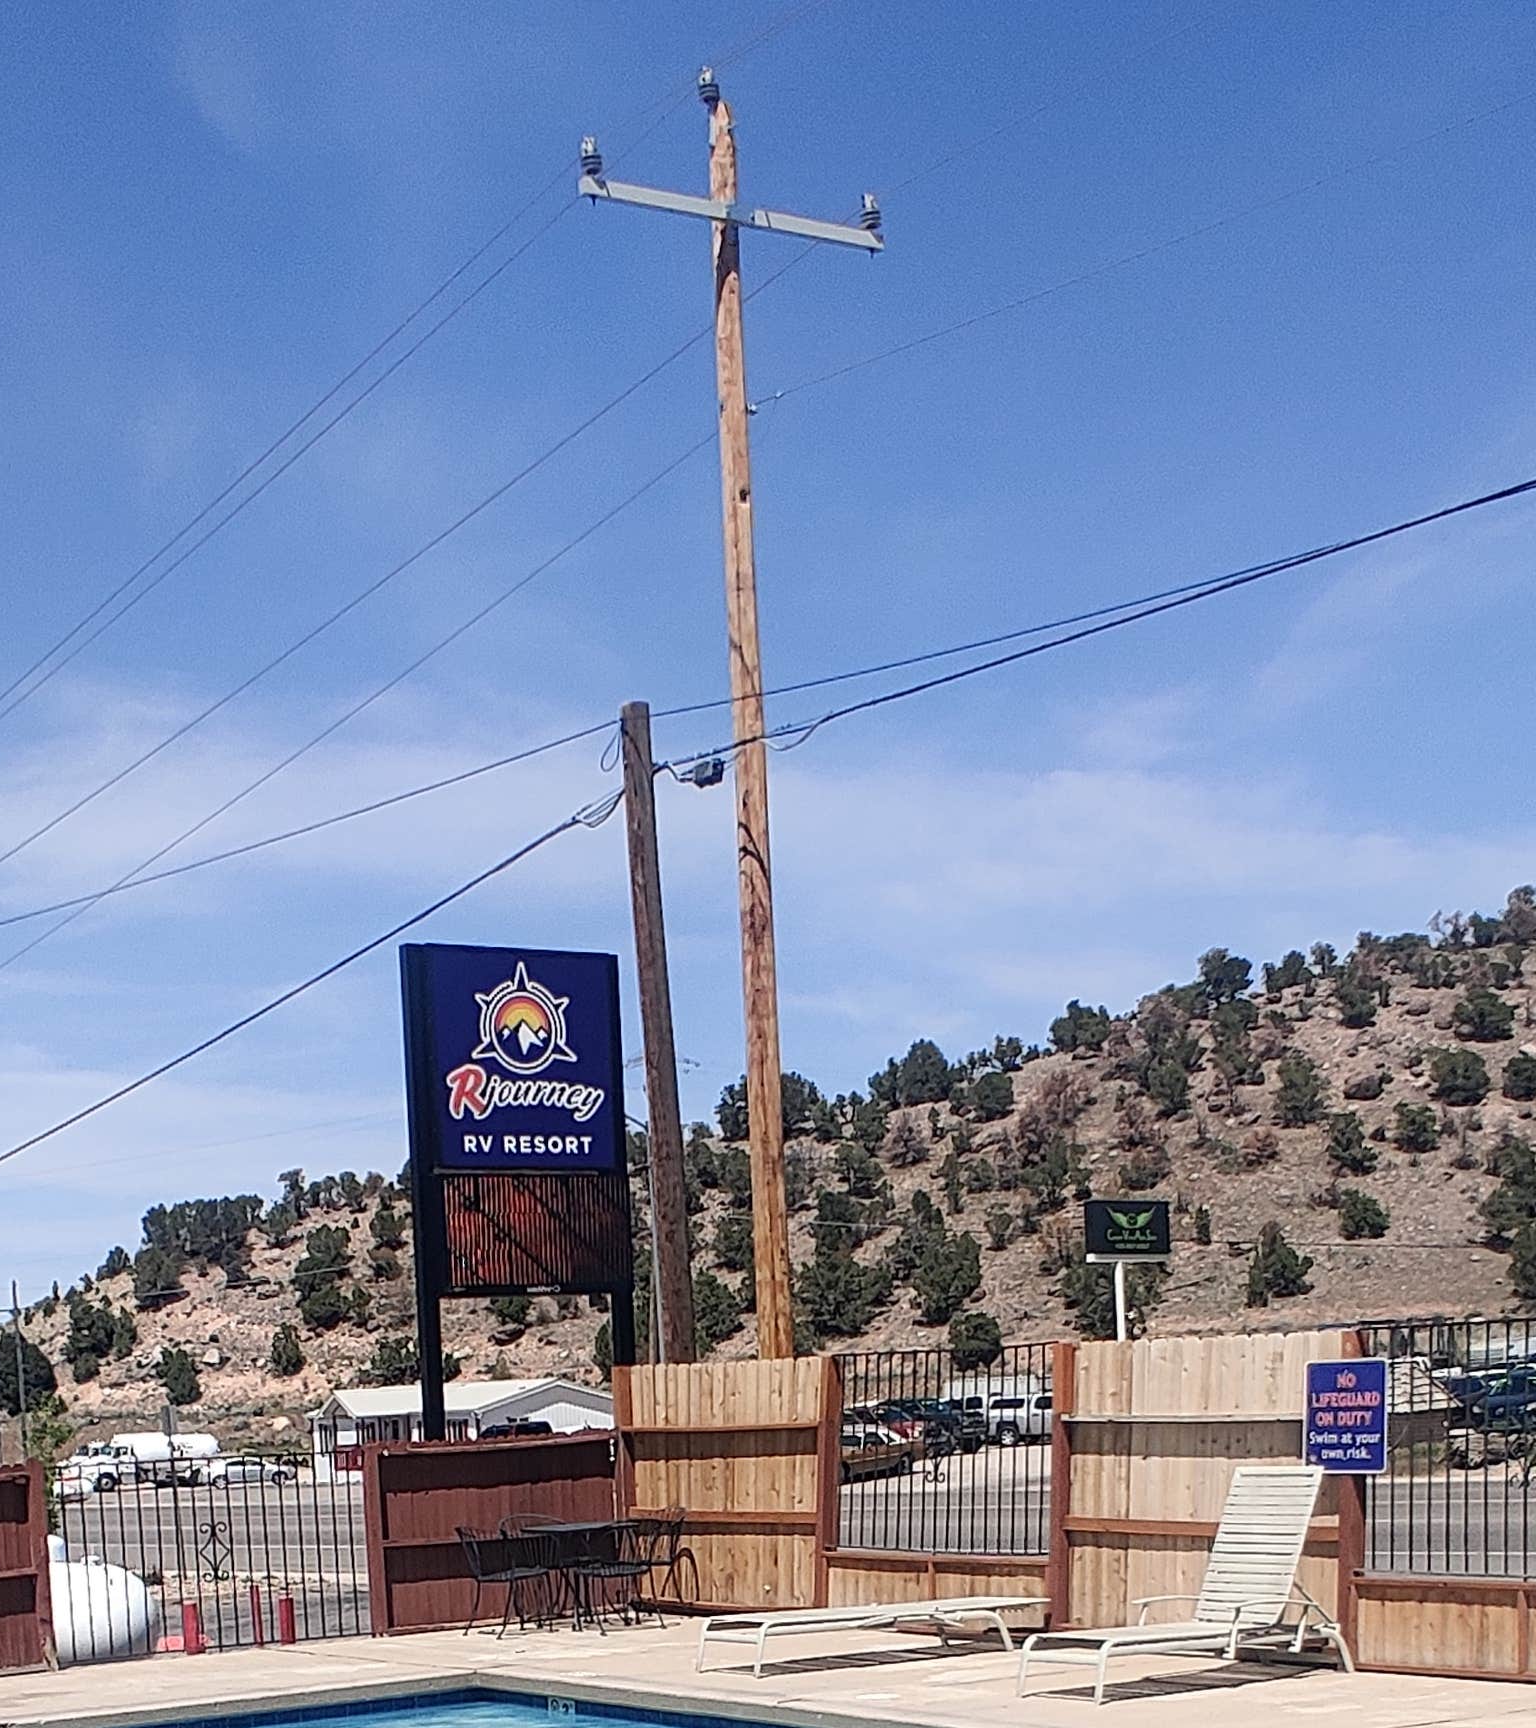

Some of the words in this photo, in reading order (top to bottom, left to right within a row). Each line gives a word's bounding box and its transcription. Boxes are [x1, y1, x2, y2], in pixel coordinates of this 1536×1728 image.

[446, 1063, 605, 1122] Rjourney
[464, 1135, 493, 1154] RV
[503, 1135, 592, 1154] RESORT
[1336, 1371, 1357, 1389] NO
[1311, 1391, 1381, 1408] LIFEGUARD
[1315, 1411, 1334, 1427] ON
[1337, 1410, 1373, 1427] DUTY
[1309, 1431, 1337, 1444] Swim
[1341, 1432, 1353, 1444] at
[1355, 1433, 1381, 1446] your
[1321, 1448, 1344, 1460] own
[1346, 1446, 1371, 1459] risk.
